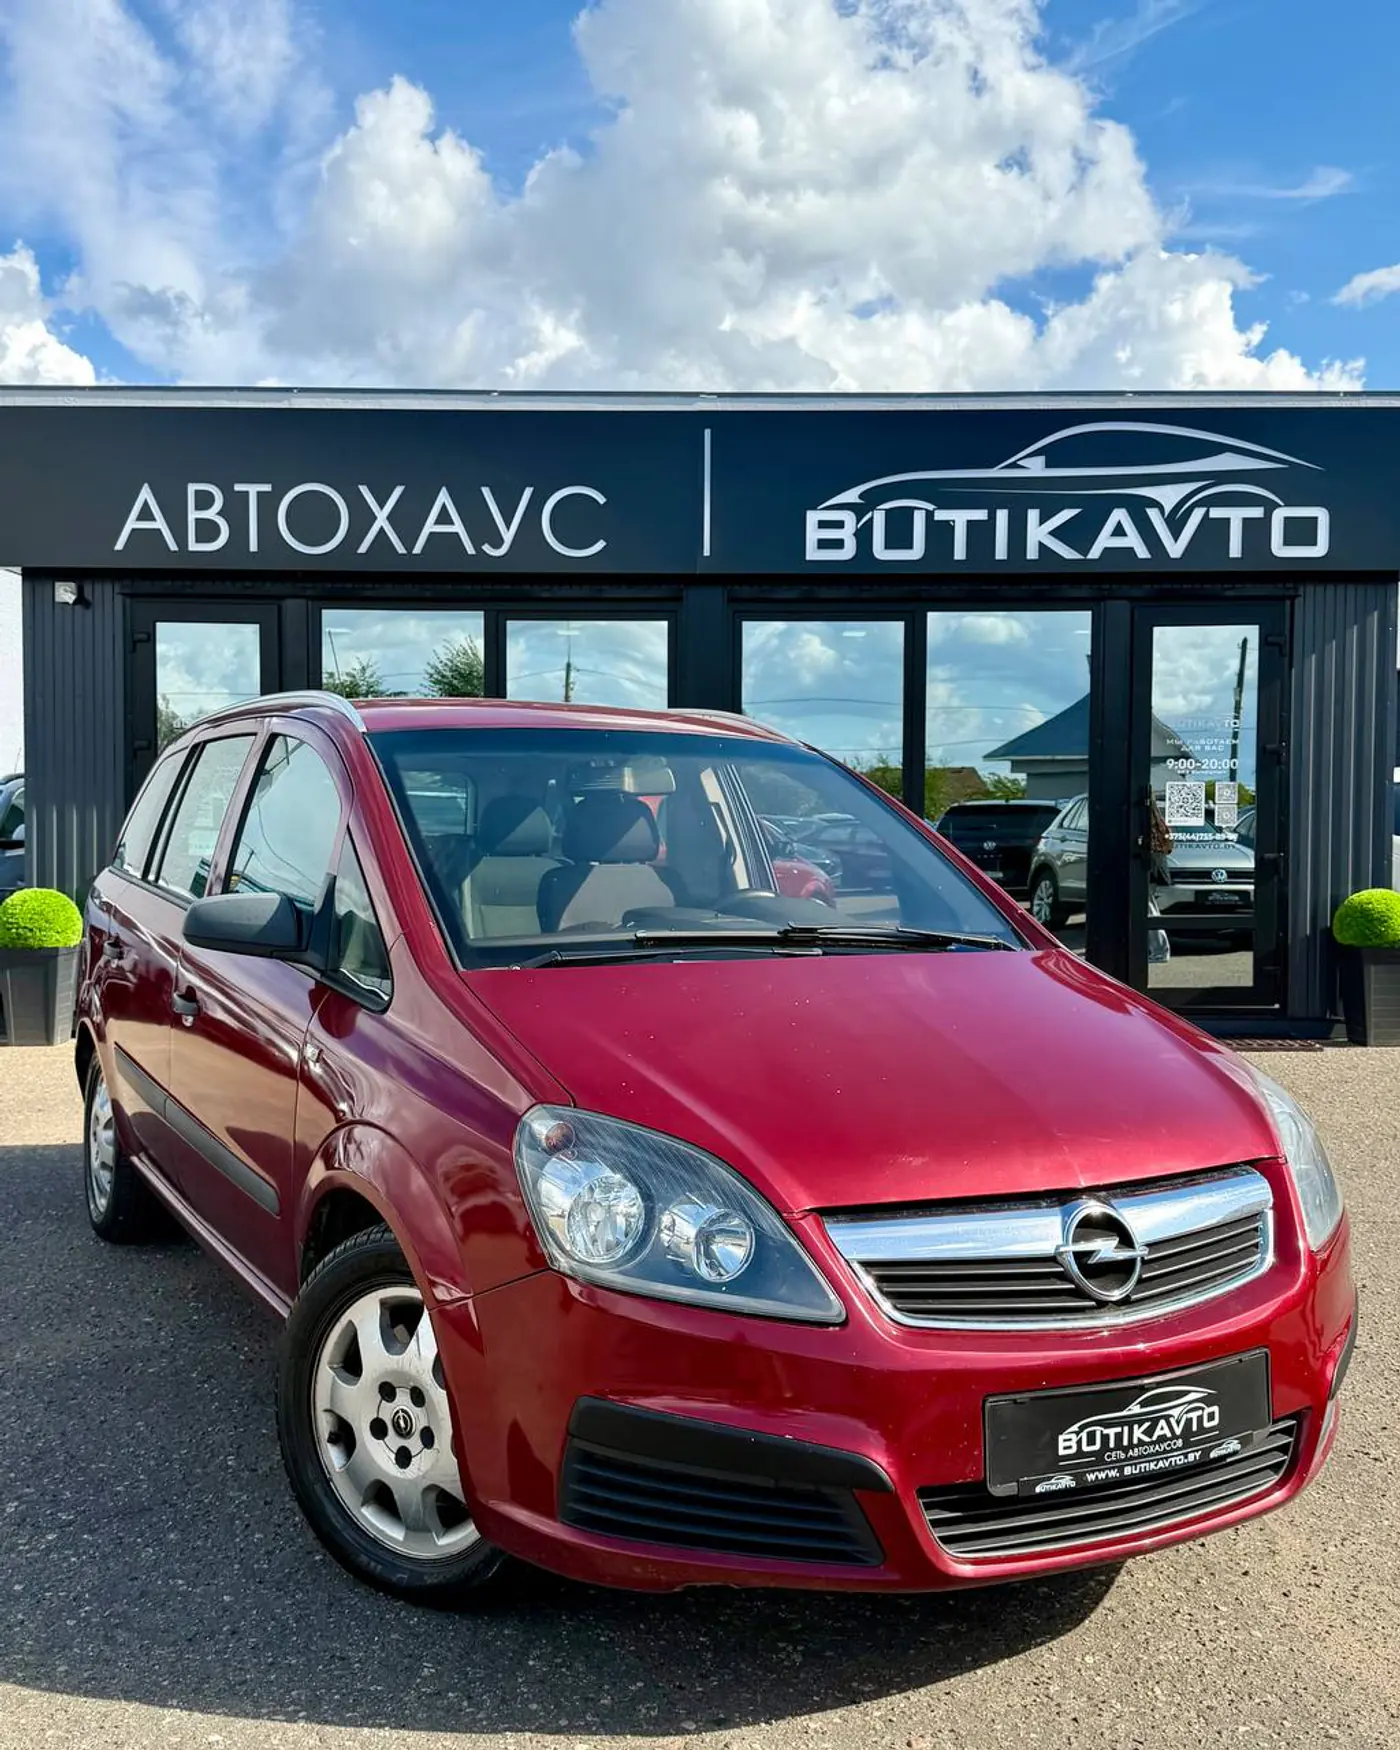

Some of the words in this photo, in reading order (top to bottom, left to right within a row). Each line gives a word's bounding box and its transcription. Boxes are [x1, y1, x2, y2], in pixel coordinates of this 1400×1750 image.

[113, 481, 609, 558] АВТОХАУС
[804, 505, 1331, 562] BUTIKAVTO
[1166, 758, 1239, 770] 9:00-20:00
[1058, 1405, 1219, 1456] BUTIKAVTO
[1104, 1451, 1127, 1462] СЕТЬ
[1127, 1438, 1184, 1457] АВТОХАУСОВ
[1086, 1469, 1120, 1482] WWW.
[1123, 1450, 1202, 1476] BUTIKAVTO.BY
